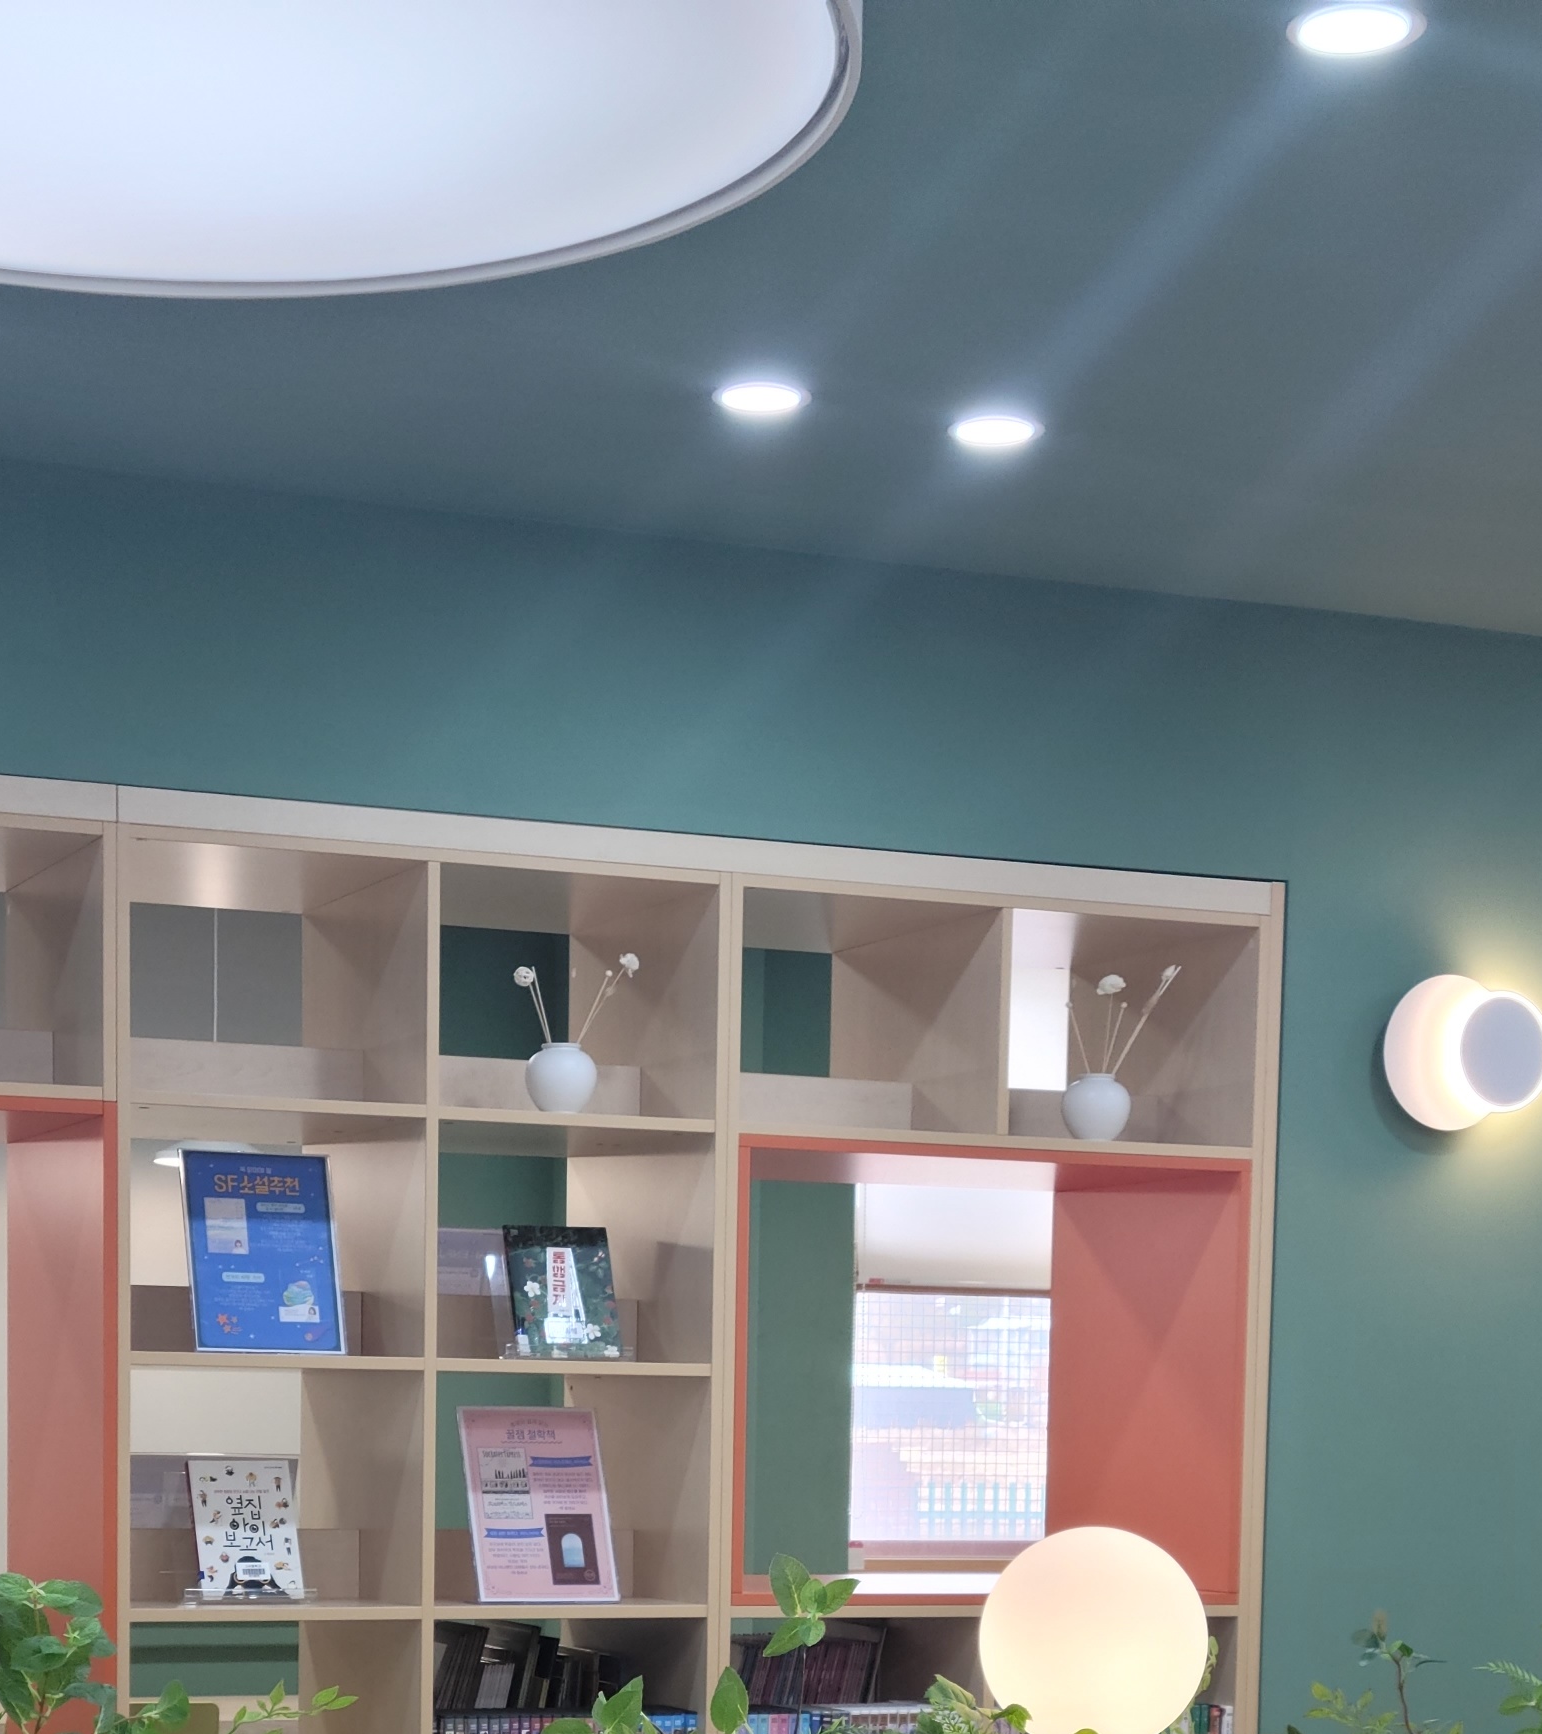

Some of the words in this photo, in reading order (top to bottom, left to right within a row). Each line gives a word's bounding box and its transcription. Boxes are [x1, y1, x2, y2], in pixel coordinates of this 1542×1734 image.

[239, 1175, 300, 1196] 소설추천
[506, 1429, 525, 1440] 꿀잼
[527, 1429, 556, 1440] 철학책
[225, 1494, 262, 1520] 옆집
[229, 1517, 266, 1536] 아이
[223, 1531, 274, 1551] 보고서
